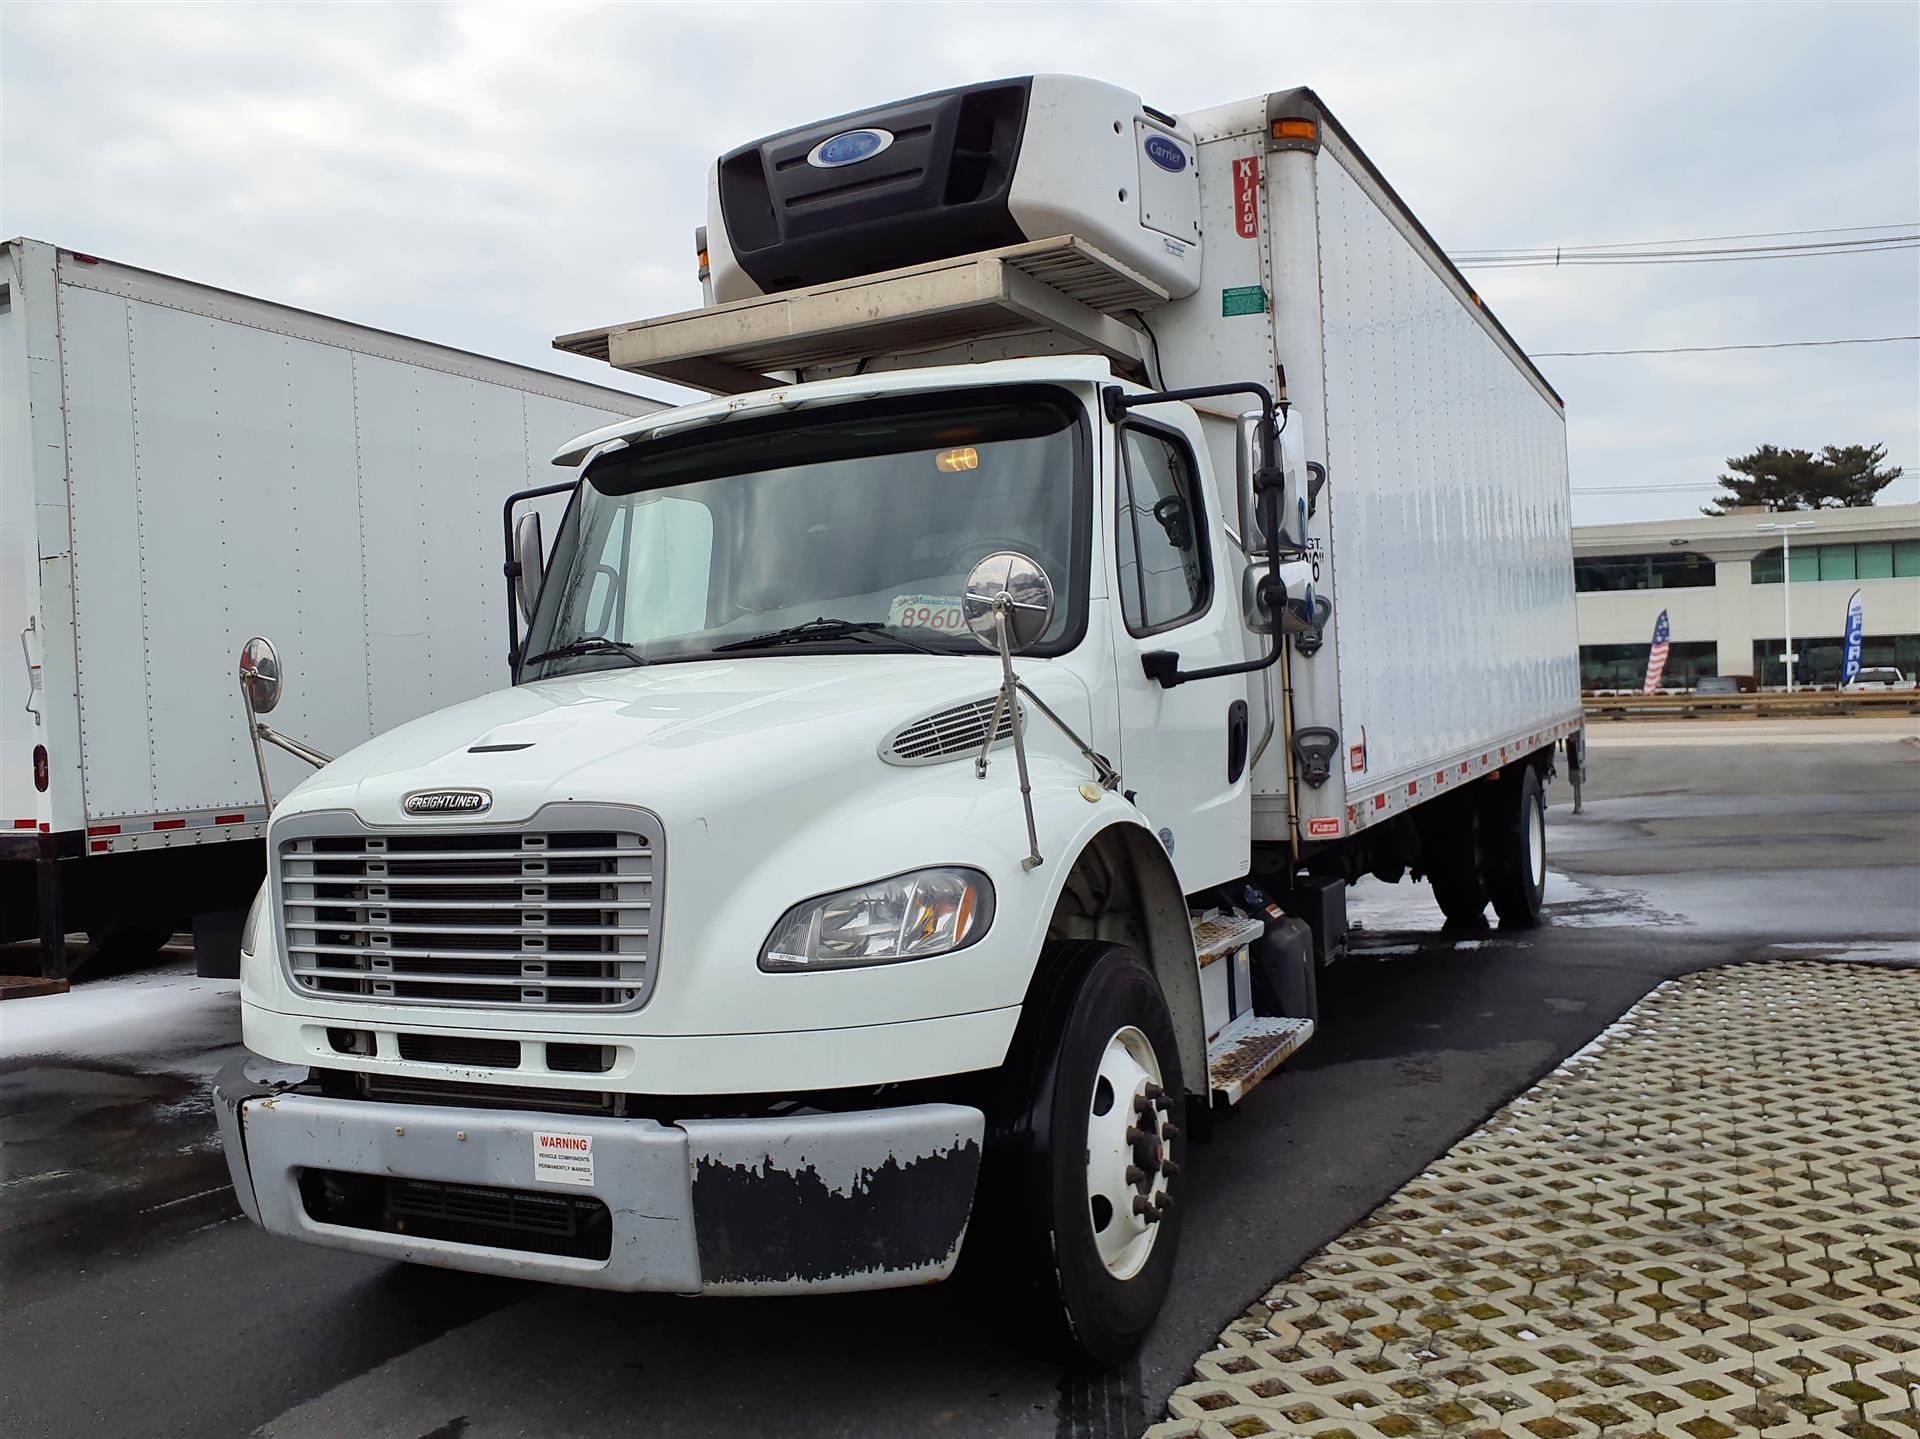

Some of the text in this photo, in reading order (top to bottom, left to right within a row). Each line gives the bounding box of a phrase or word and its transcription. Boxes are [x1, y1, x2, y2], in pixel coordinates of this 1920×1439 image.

[1150, 141, 1181, 164] Carrier
[1239, 160, 1254, 233] Kidron
[1306, 538, 1323, 550] GT.
[912, 596, 961, 606] Massachuse
[901, 607, 964, 628] 8960
[409, 795, 479, 807] FREIGHTLINER
[540, 1136, 587, 1150] WARNING
[558, 1154, 590, 1162] COMPONENTS
[538, 1163, 570, 1171] PERMANENTLY
